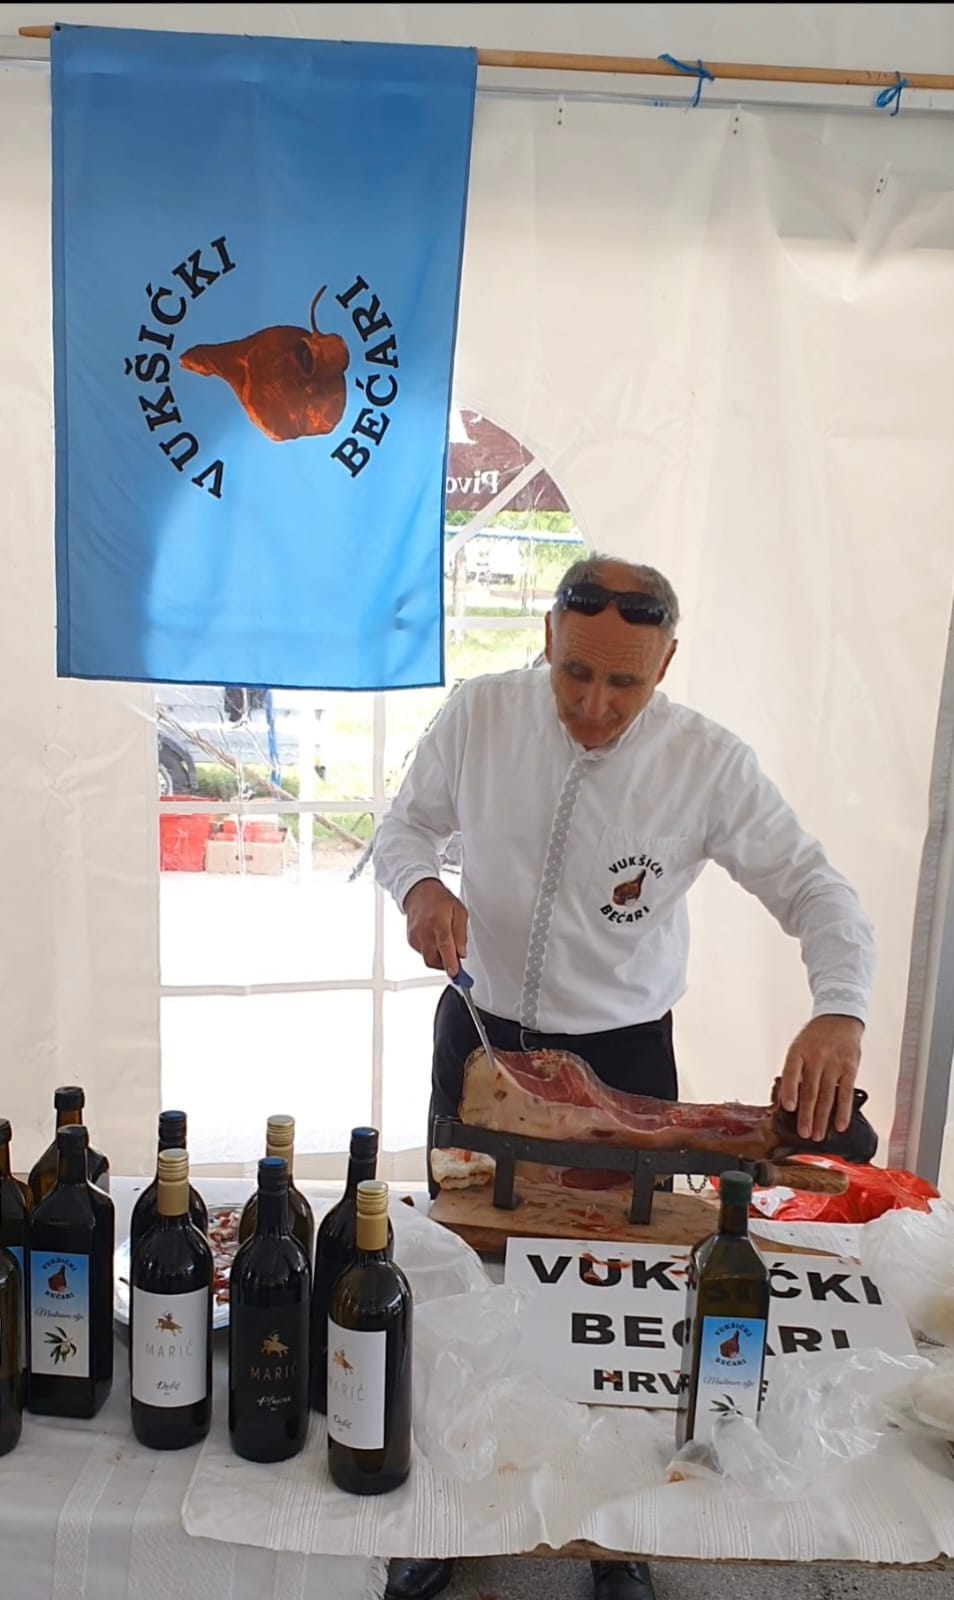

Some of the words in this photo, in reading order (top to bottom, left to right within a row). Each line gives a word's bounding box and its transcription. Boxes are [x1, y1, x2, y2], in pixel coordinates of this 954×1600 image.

[123, 236, 236, 499] VUKŠIĆKI
[330, 275, 399, 478] BEĆARI
[600, 903, 650, 924] BEĆARI
[526, 1254, 883, 1306] VUKĆKI
[571, 1312, 850, 1357] BERI
